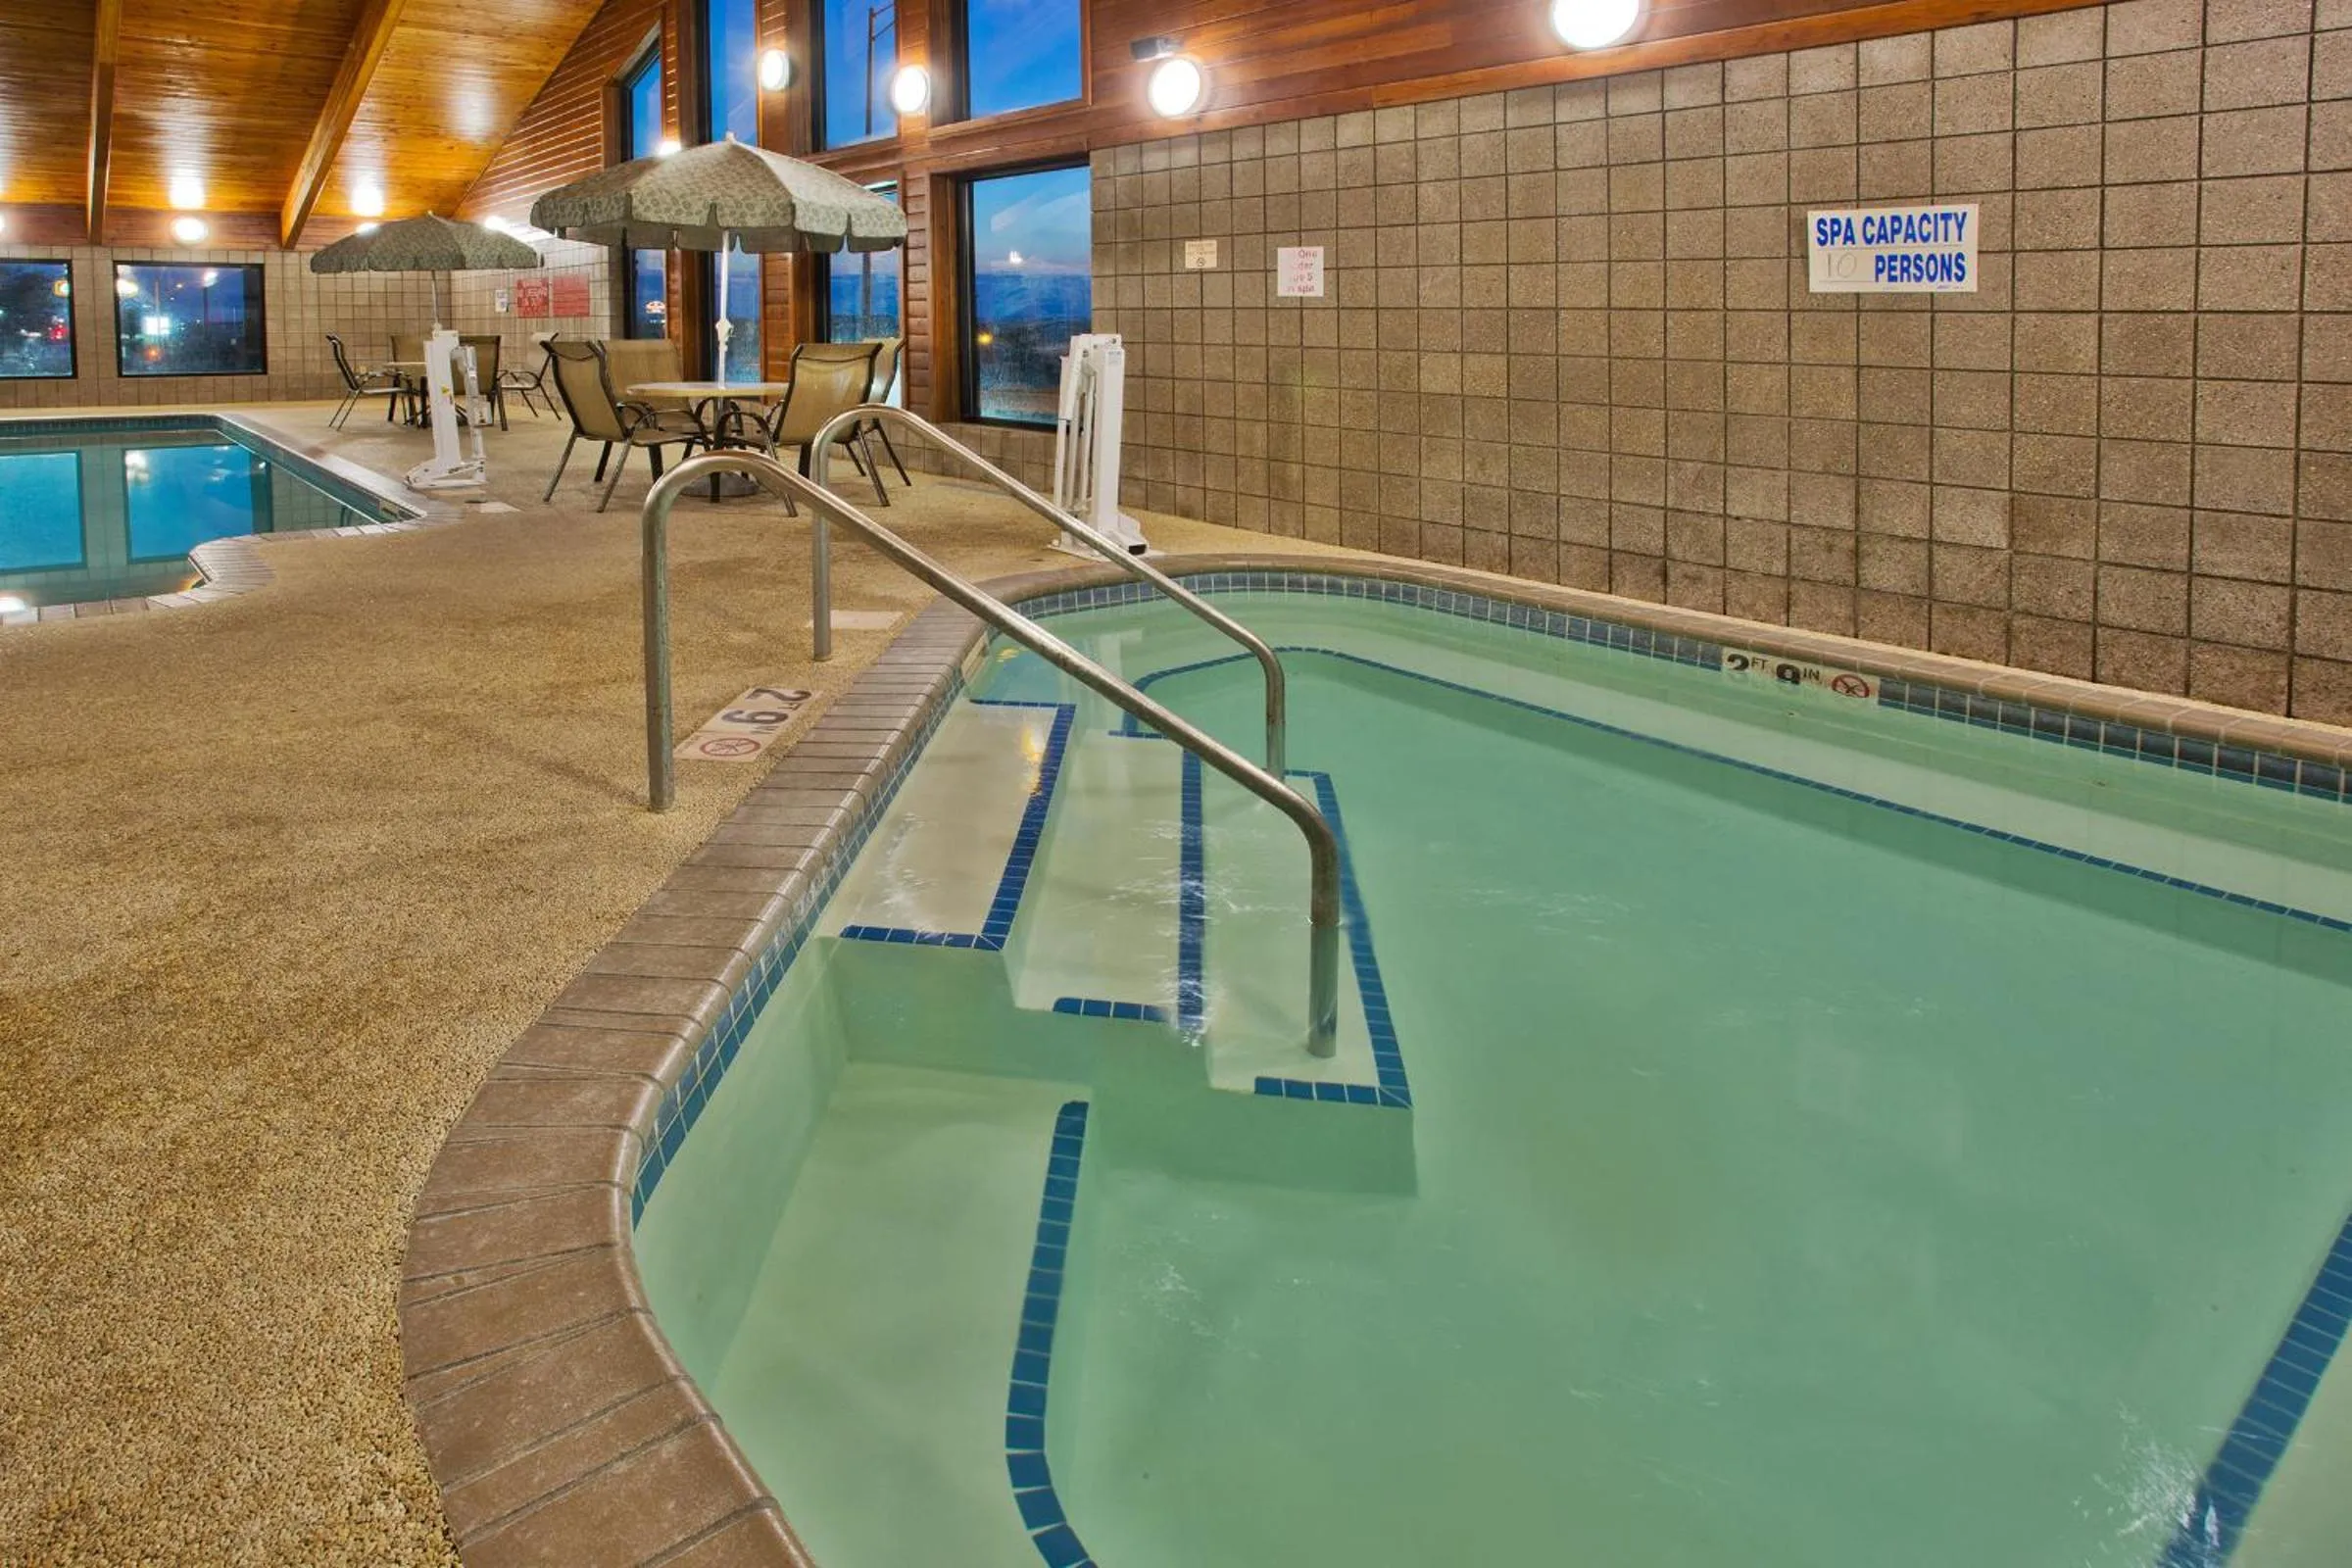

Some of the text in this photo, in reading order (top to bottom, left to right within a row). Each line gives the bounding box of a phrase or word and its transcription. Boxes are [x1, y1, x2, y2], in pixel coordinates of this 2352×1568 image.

[1816, 212, 1968, 246] SPA CAPACITY
[1827, 252, 1966, 282] 10 PERSONS
[1727, 654, 1749, 670] 2
[1751, 658, 1770, 670] FT
[1802, 667, 1820, 681] IN
[745, 688, 812, 702] 2
